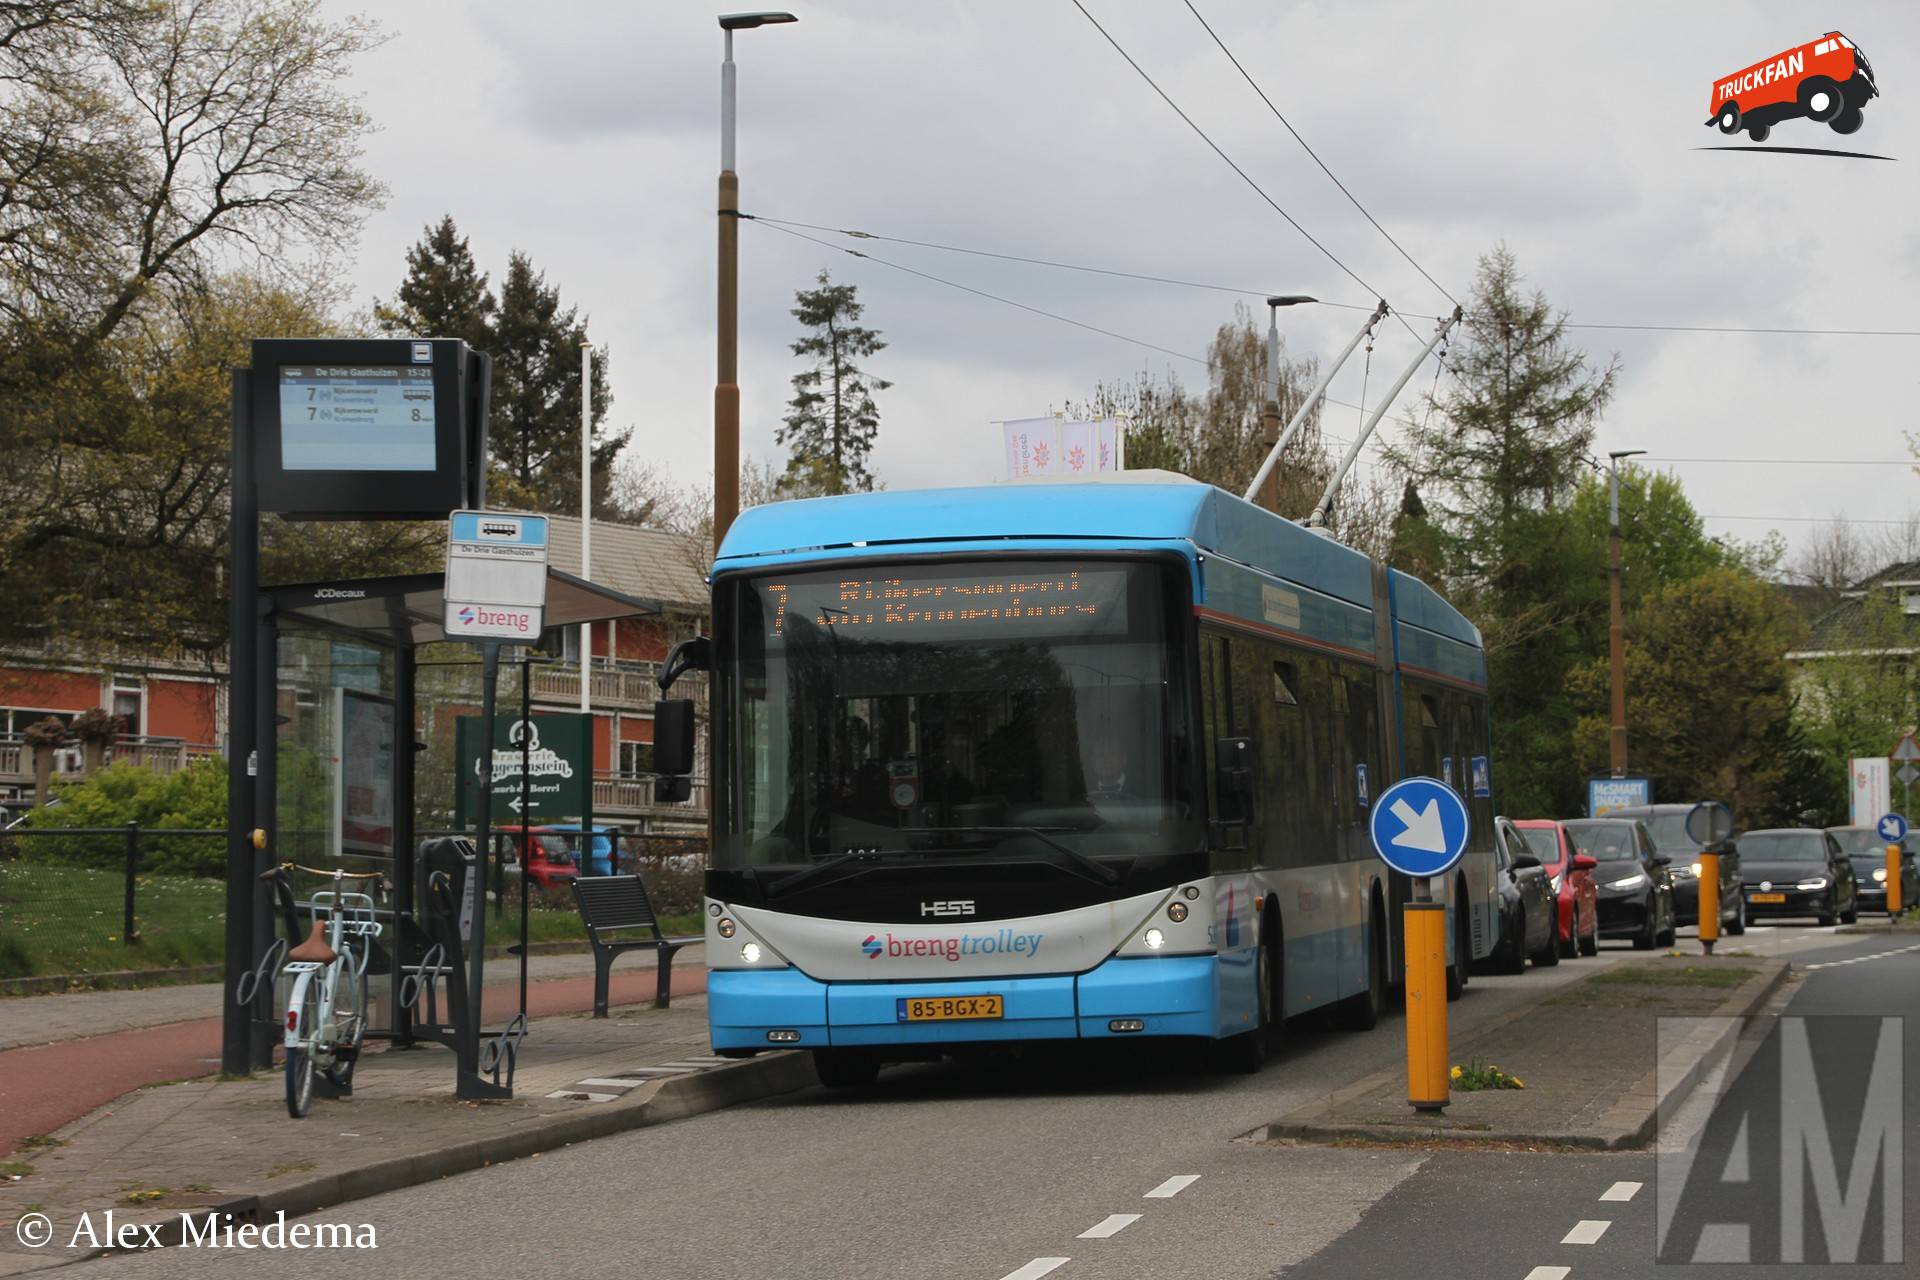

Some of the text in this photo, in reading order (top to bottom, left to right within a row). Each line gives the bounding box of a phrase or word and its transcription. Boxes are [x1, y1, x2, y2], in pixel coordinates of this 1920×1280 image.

[315, 368, 398, 377] De Drie Gasthuizen
[306, 387, 317, 402] 7
[307, 407, 318, 421] 7
[411, 408, 421, 422] 8
[462, 545, 473, 553] De
[474, 545, 490, 554] Drie
[314, 588, 367, 599] JCDecaux
[768, 585, 788, 635] 7
[477, 606, 529, 632] breng
[920, 900, 976, 916] HESS
[912, 999, 997, 1018] 85-BGX-2
